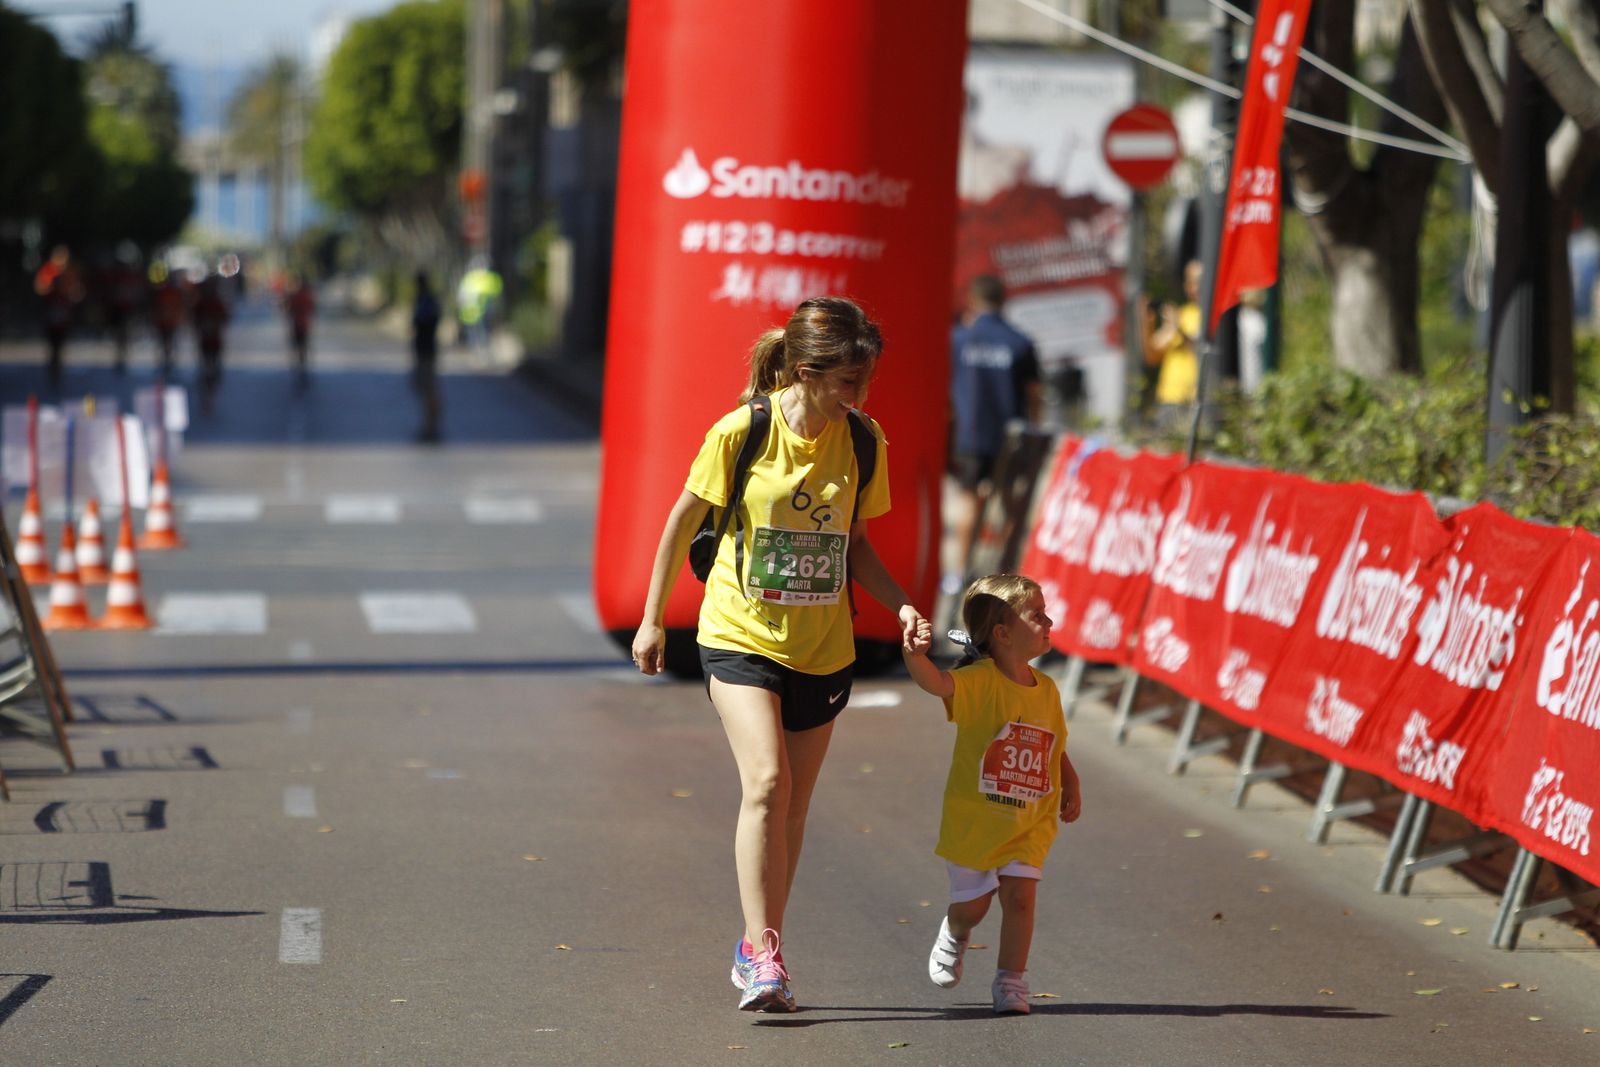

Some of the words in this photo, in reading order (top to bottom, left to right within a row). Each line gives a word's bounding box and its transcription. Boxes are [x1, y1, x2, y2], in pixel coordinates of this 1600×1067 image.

[710, 155, 910, 207] Santander
[762, 551, 831, 579] 1262
[786, 579, 812, 590] MARTA
[1002, 745, 1043, 775] 304
